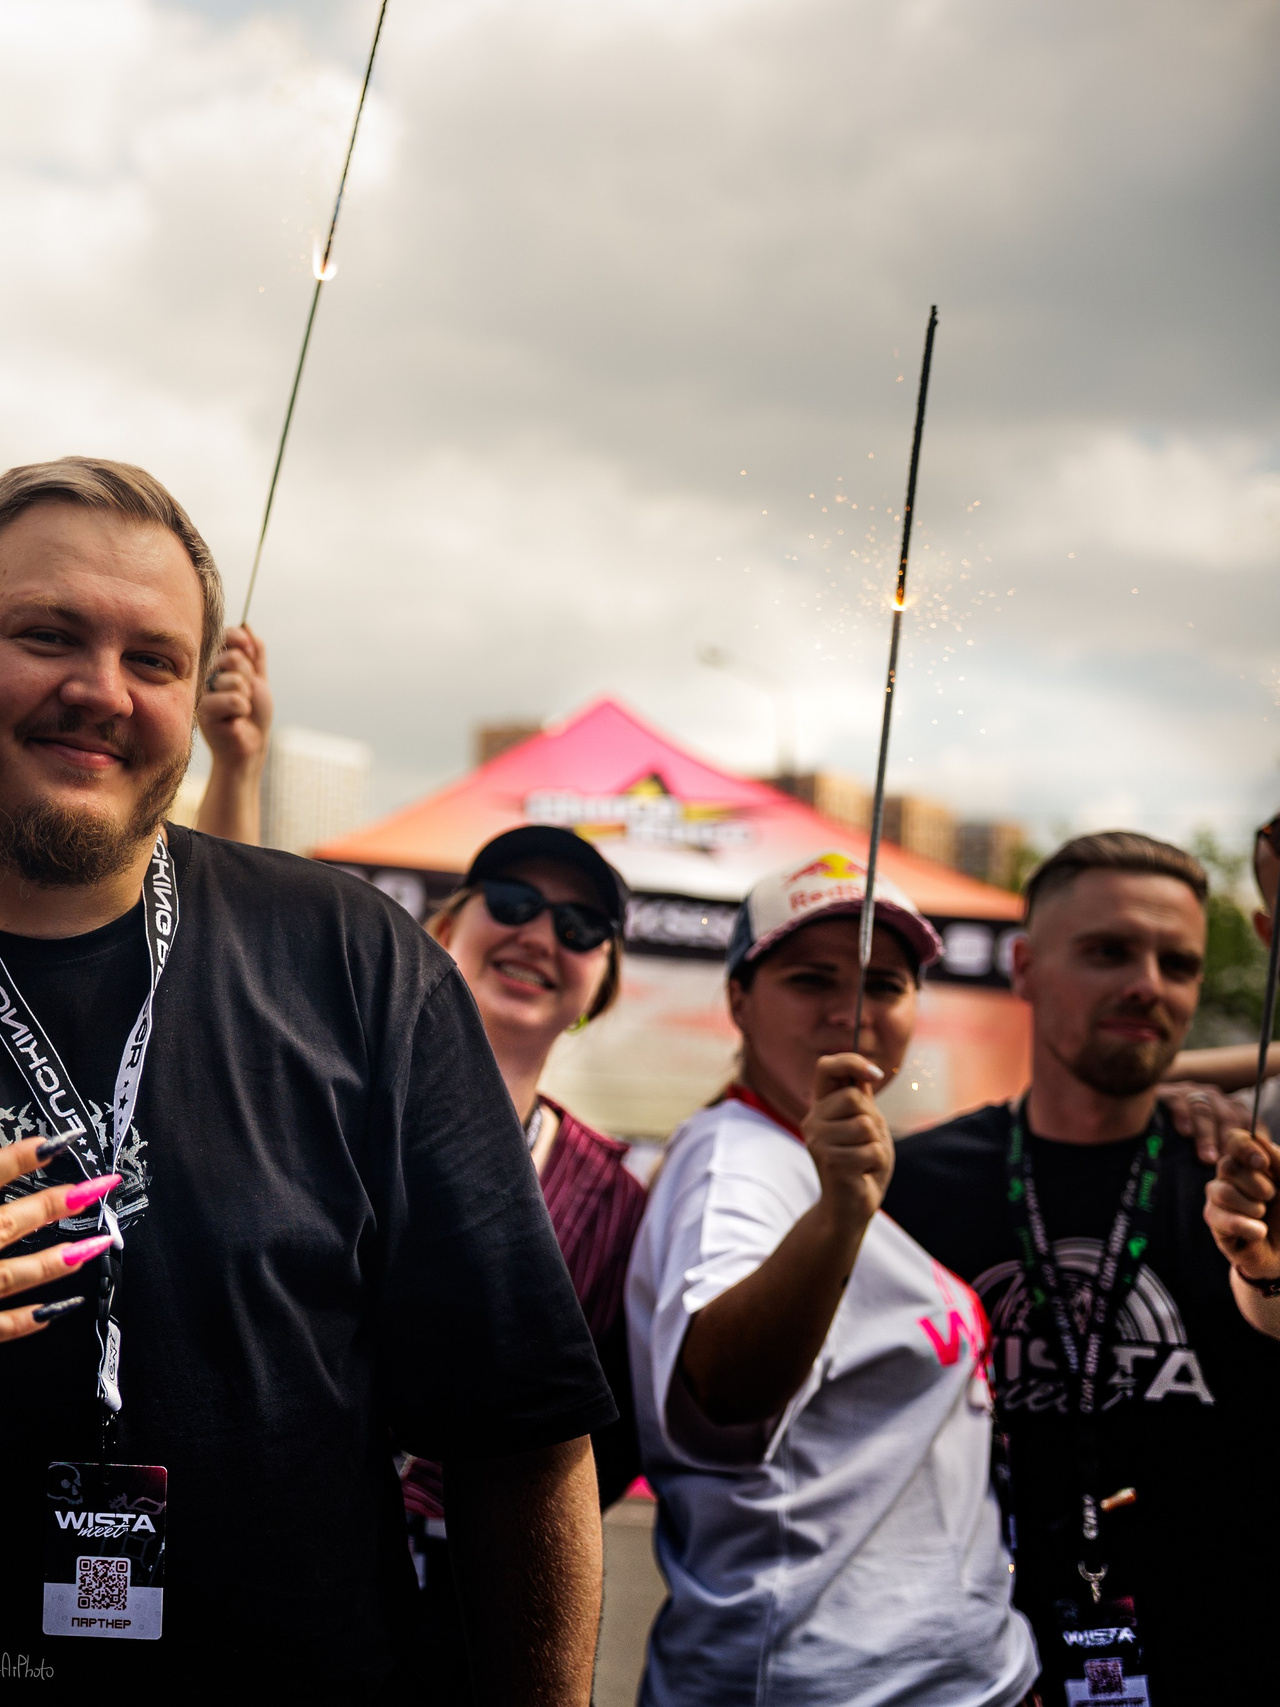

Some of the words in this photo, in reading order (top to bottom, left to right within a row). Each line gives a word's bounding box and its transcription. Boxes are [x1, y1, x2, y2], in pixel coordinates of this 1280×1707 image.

[54, 1510, 157, 1533] WISTA
[77, 1521, 131, 1539] meet
[70, 1616, 132, 1630] ПАРТНЕР
